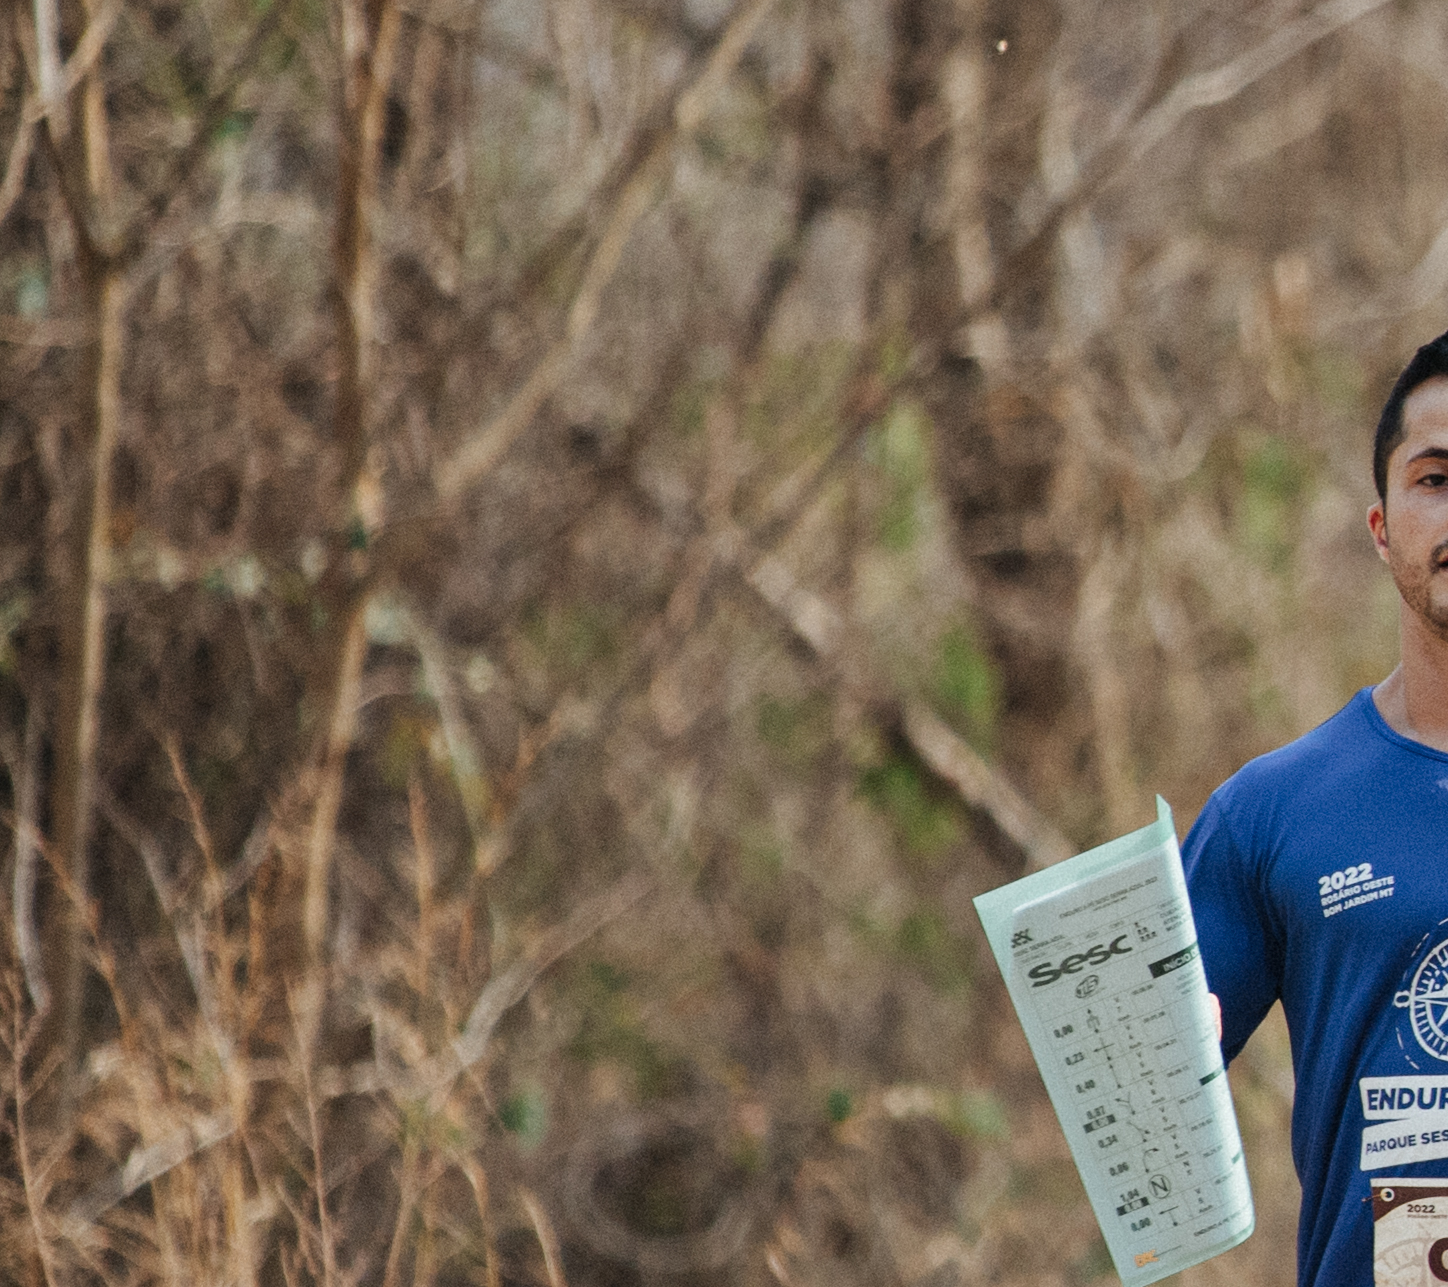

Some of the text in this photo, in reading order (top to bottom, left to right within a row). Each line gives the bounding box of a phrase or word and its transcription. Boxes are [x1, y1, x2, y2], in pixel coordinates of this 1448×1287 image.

[1318, 863, 1373, 895] 2022
[1321, 876, 1395, 906] ROSÁRIO OESTE
[1323, 887, 1394, 918] BOM JARDIM MT
[1366, 1134, 1417, 1155] PARQUE
[1407, 1204, 1435, 1213] 2022
